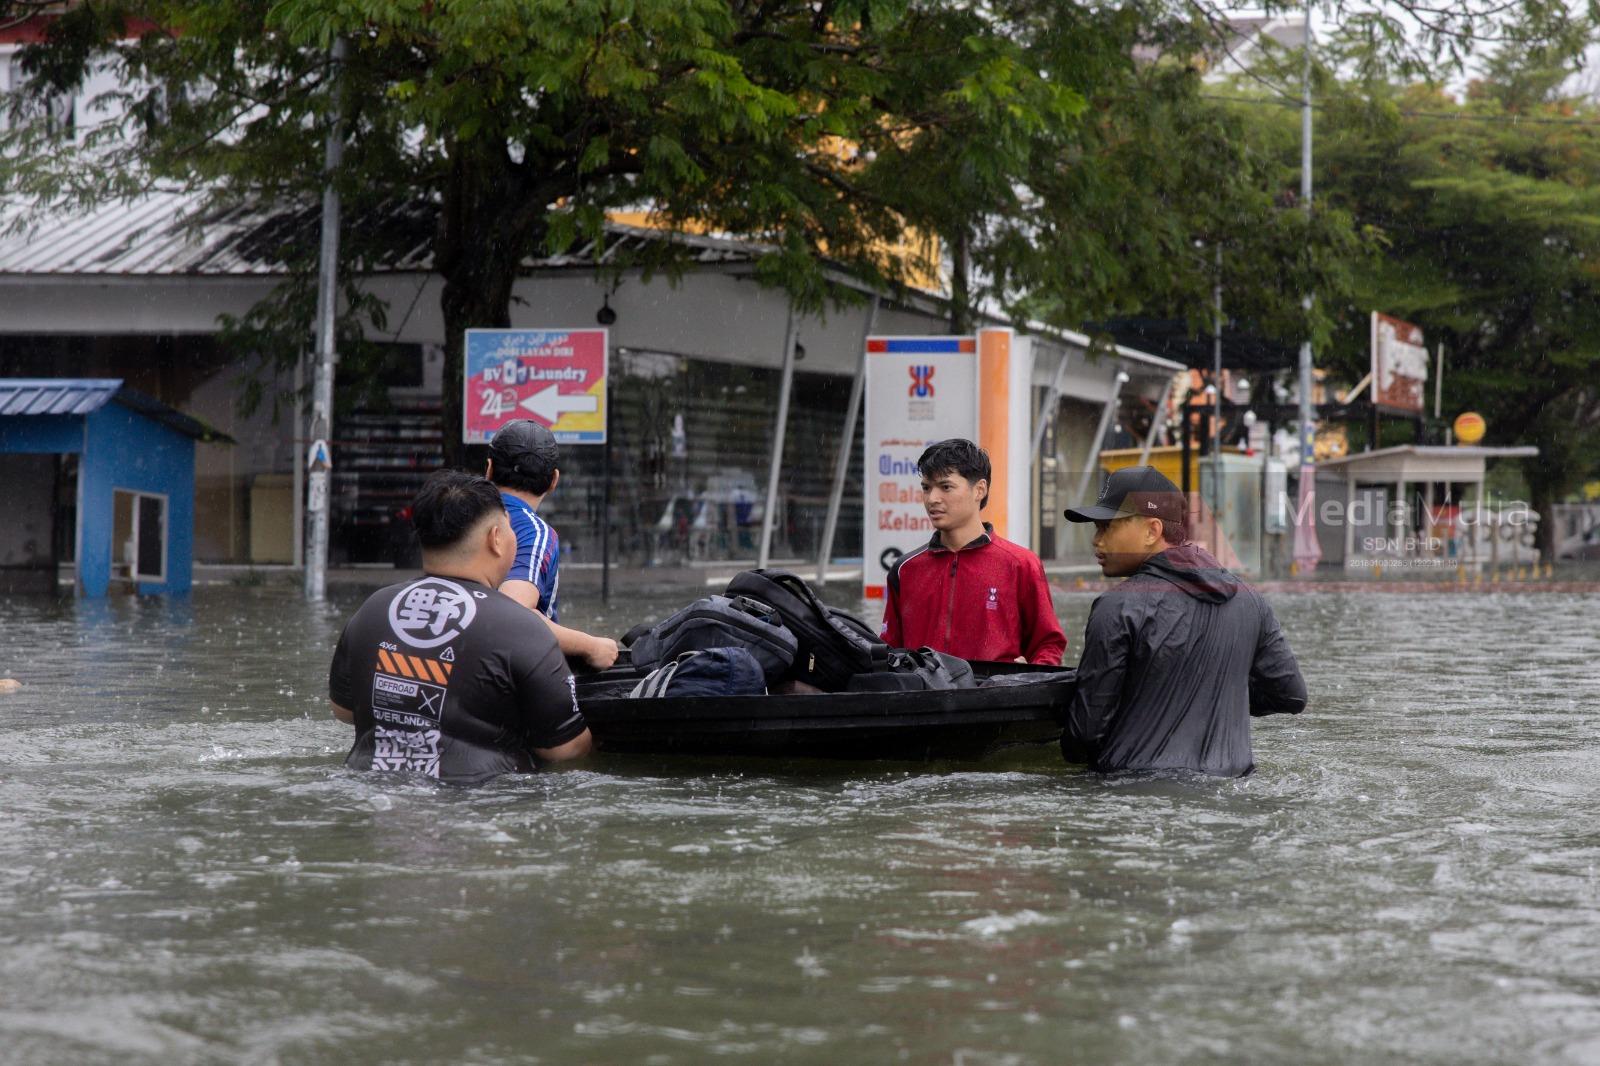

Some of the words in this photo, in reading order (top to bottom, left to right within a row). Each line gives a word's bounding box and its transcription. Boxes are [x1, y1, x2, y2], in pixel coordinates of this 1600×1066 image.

[483, 367, 502, 383] BV
[529, 366, 588, 383] Laundry
[879, 454, 921, 475] Univ
[879, 482, 926, 503] Mala
[878, 510, 935, 531] Kelan
[378, 679, 415, 695] OFFROAD
[373, 709, 437, 727] OVERLANDE
